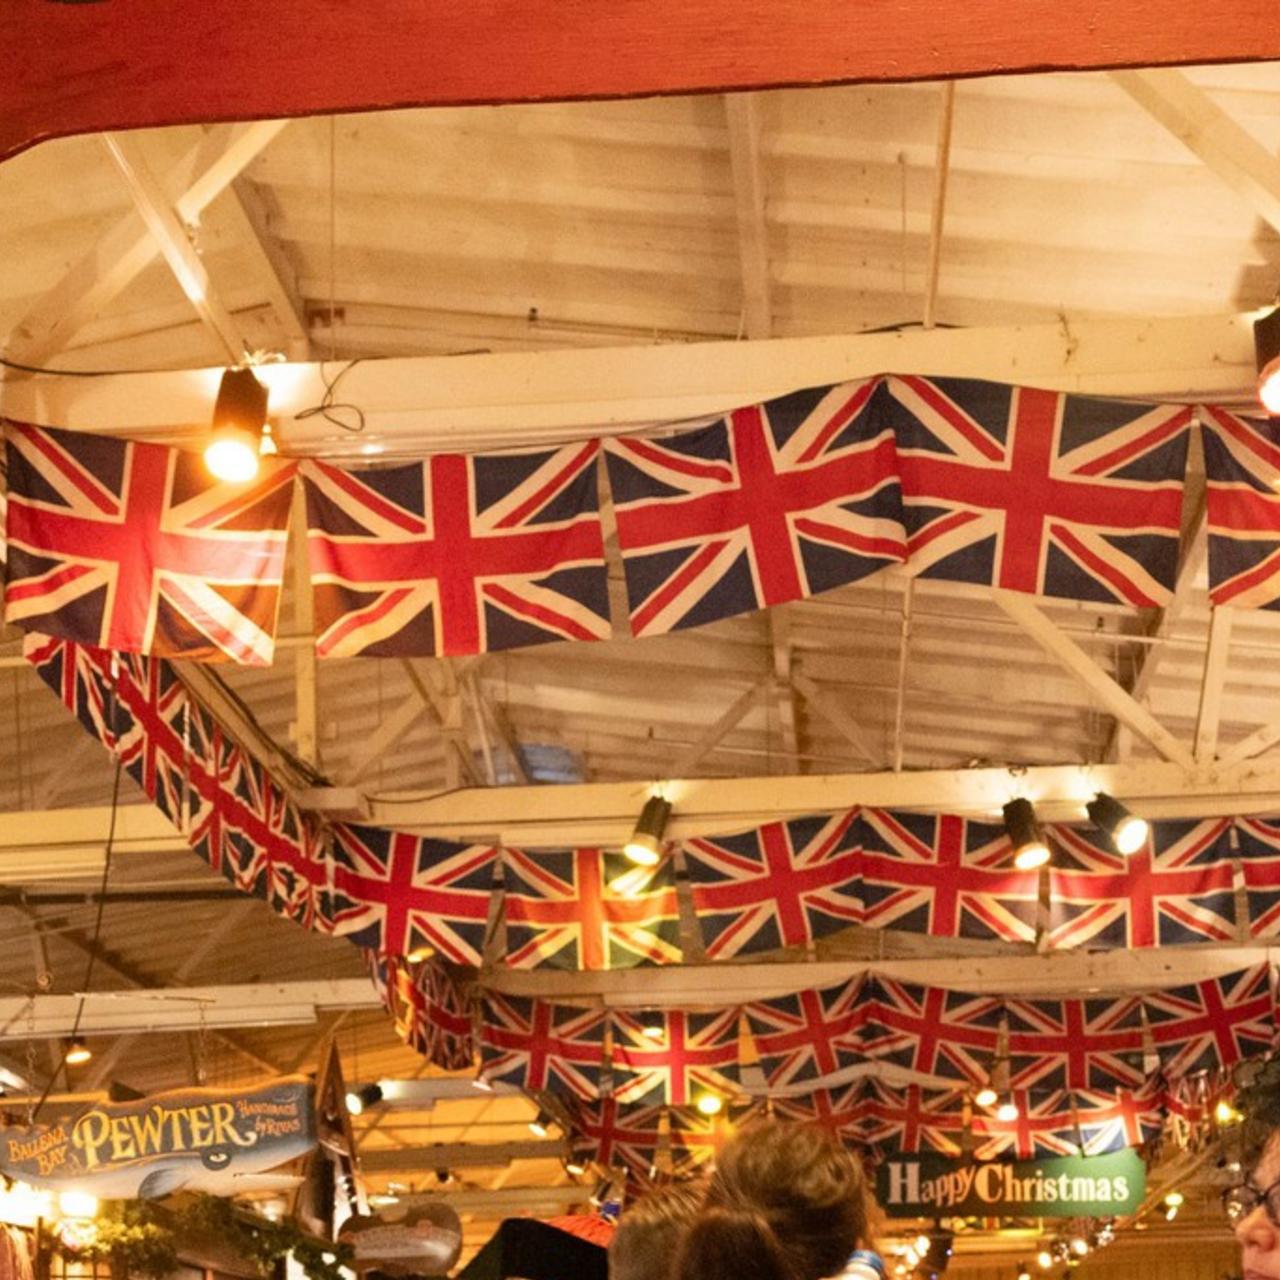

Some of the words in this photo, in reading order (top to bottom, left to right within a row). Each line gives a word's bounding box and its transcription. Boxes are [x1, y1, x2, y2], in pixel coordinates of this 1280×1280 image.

[72, 1103, 257, 1171] PEWTER
[36, 1145, 68, 1176] BAY
[888, 1162, 976, 1207] Happy
[975, 1162, 1130, 1203] Christmas
